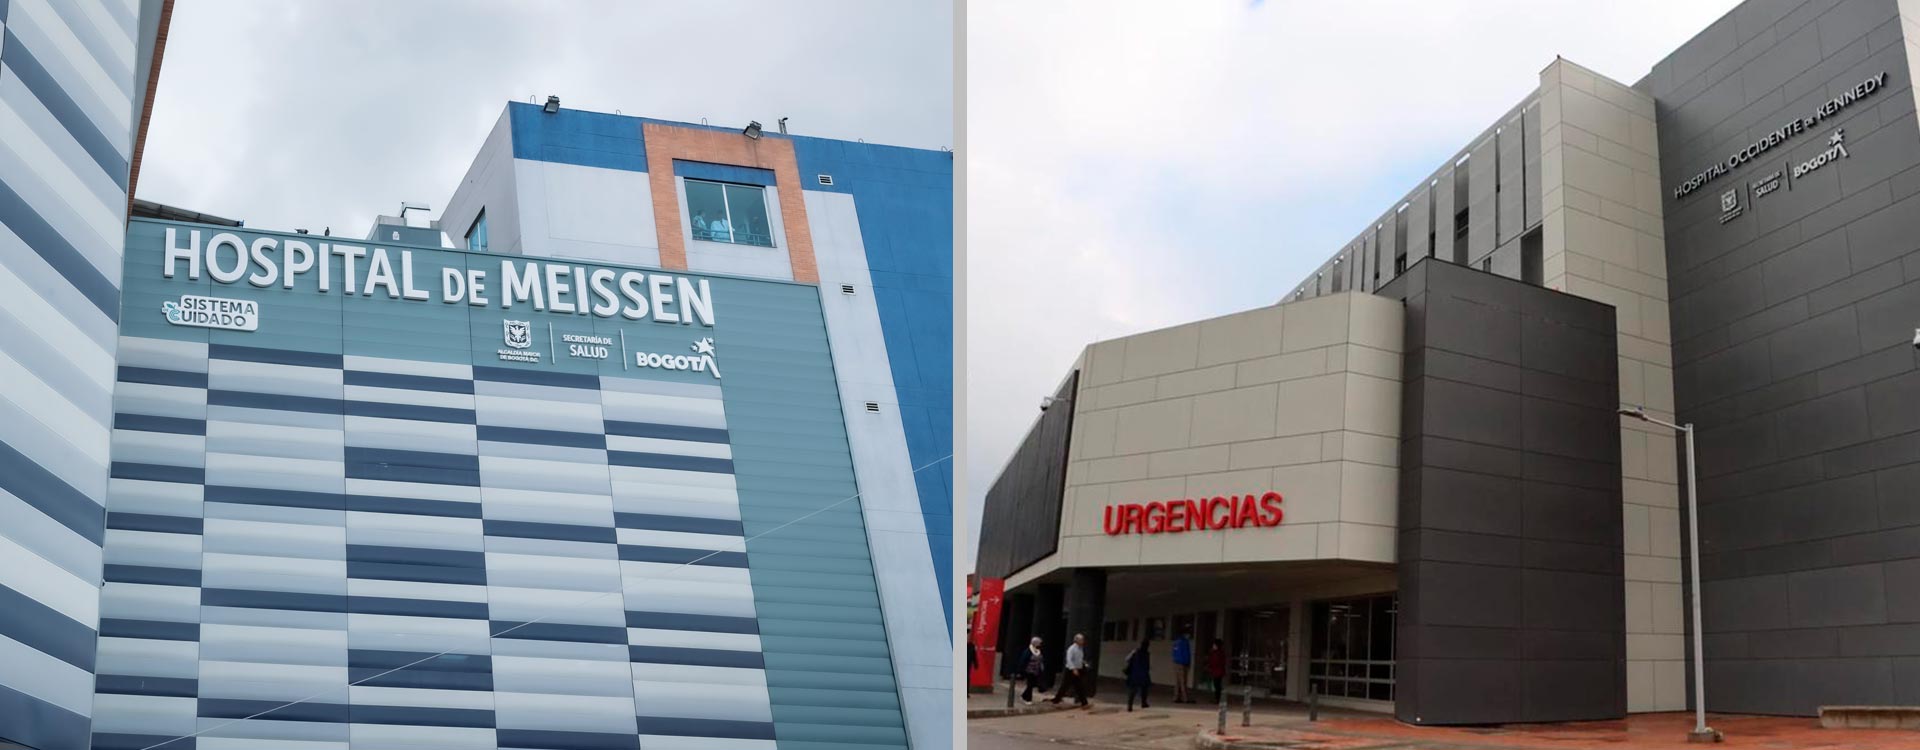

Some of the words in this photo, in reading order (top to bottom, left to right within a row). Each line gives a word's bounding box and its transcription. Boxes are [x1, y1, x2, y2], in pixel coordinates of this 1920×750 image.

[1674, 162, 1728, 198] HOSPITAL
[1729, 119, 1802, 168] OCCIDENTE
[1817, 72, 1886, 119] KENNEDY
[1756, 180, 1779, 198] SALUD
[164, 229, 429, 300] HOSPITAL
[442, 267, 488, 305] DE
[501, 260, 715, 326] MEISSEN
[184, 298, 255, 315] SISTEMA
[563, 334, 602, 345] SECRETARÍA
[570, 344, 608, 359] SALUD
[1104, 492, 1283, 535] URGENCIAS
